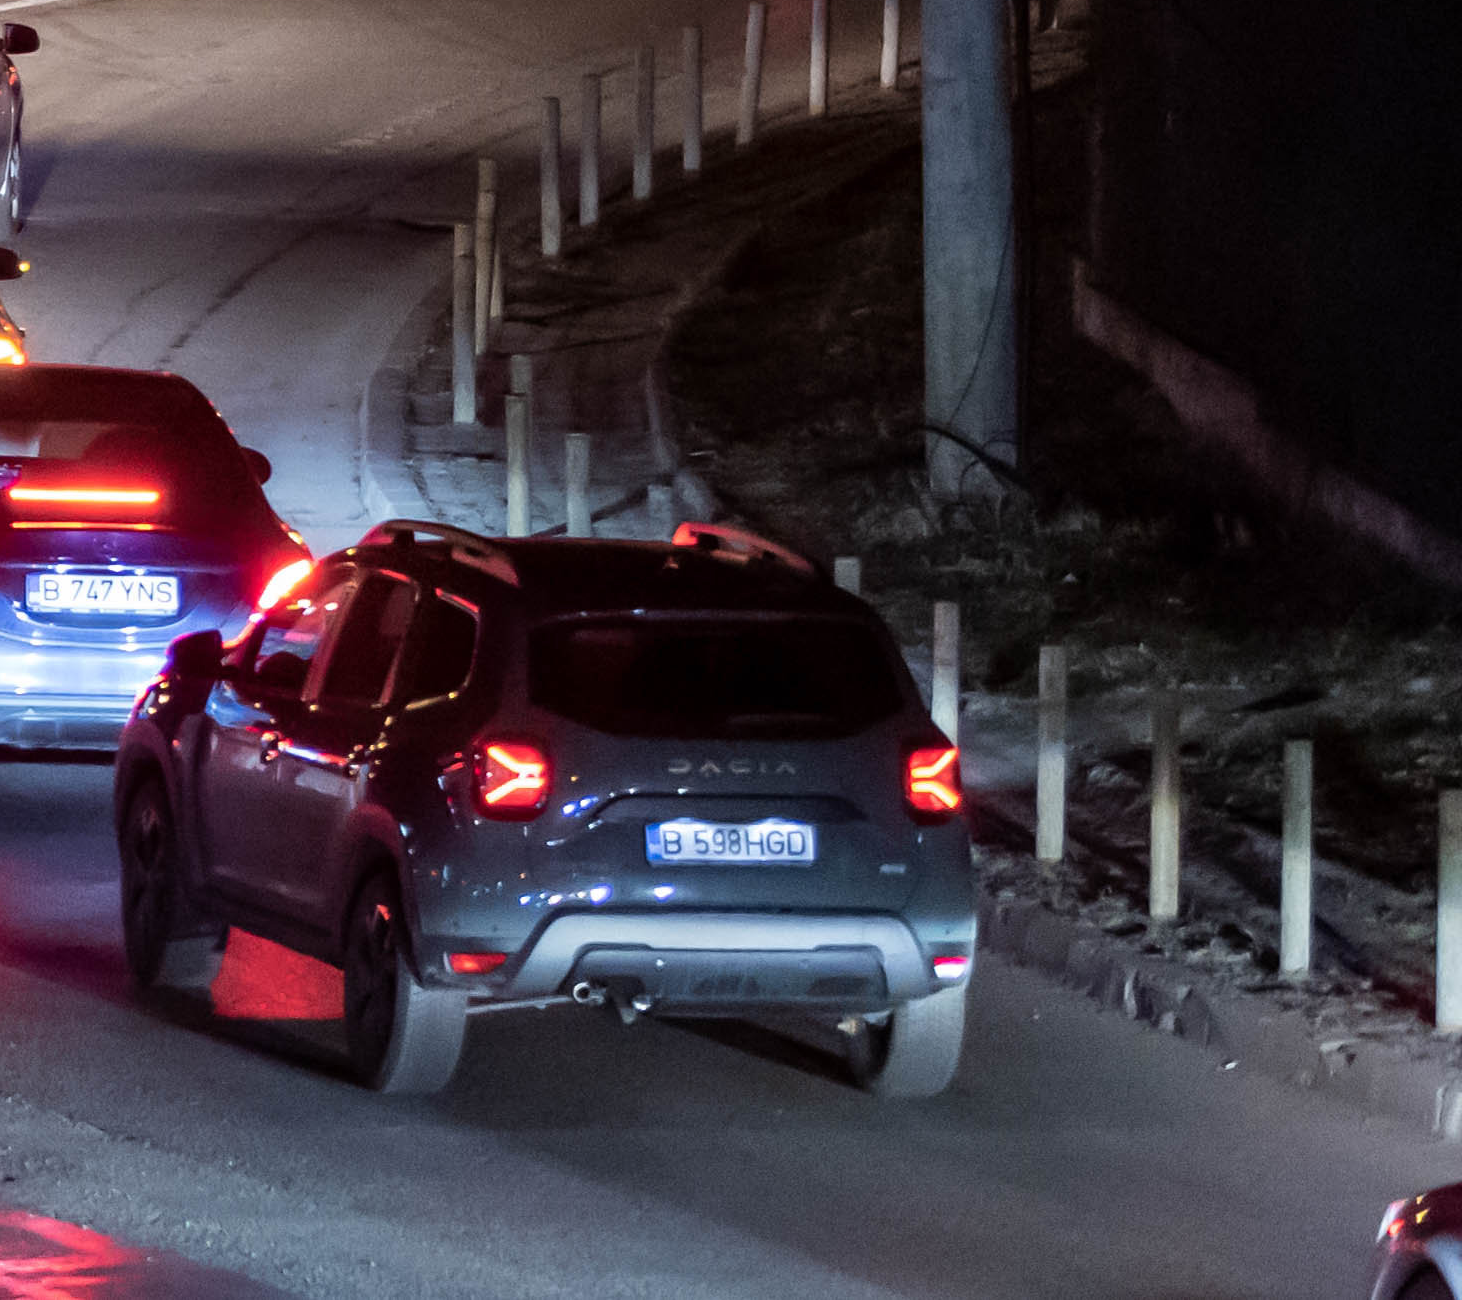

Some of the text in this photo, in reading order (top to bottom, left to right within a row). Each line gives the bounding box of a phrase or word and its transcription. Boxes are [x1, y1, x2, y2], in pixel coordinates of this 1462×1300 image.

[44, 579, 172, 603] B 747 YNS
[668, 758, 797, 776] DACIA
[664, 830, 682, 855] B
